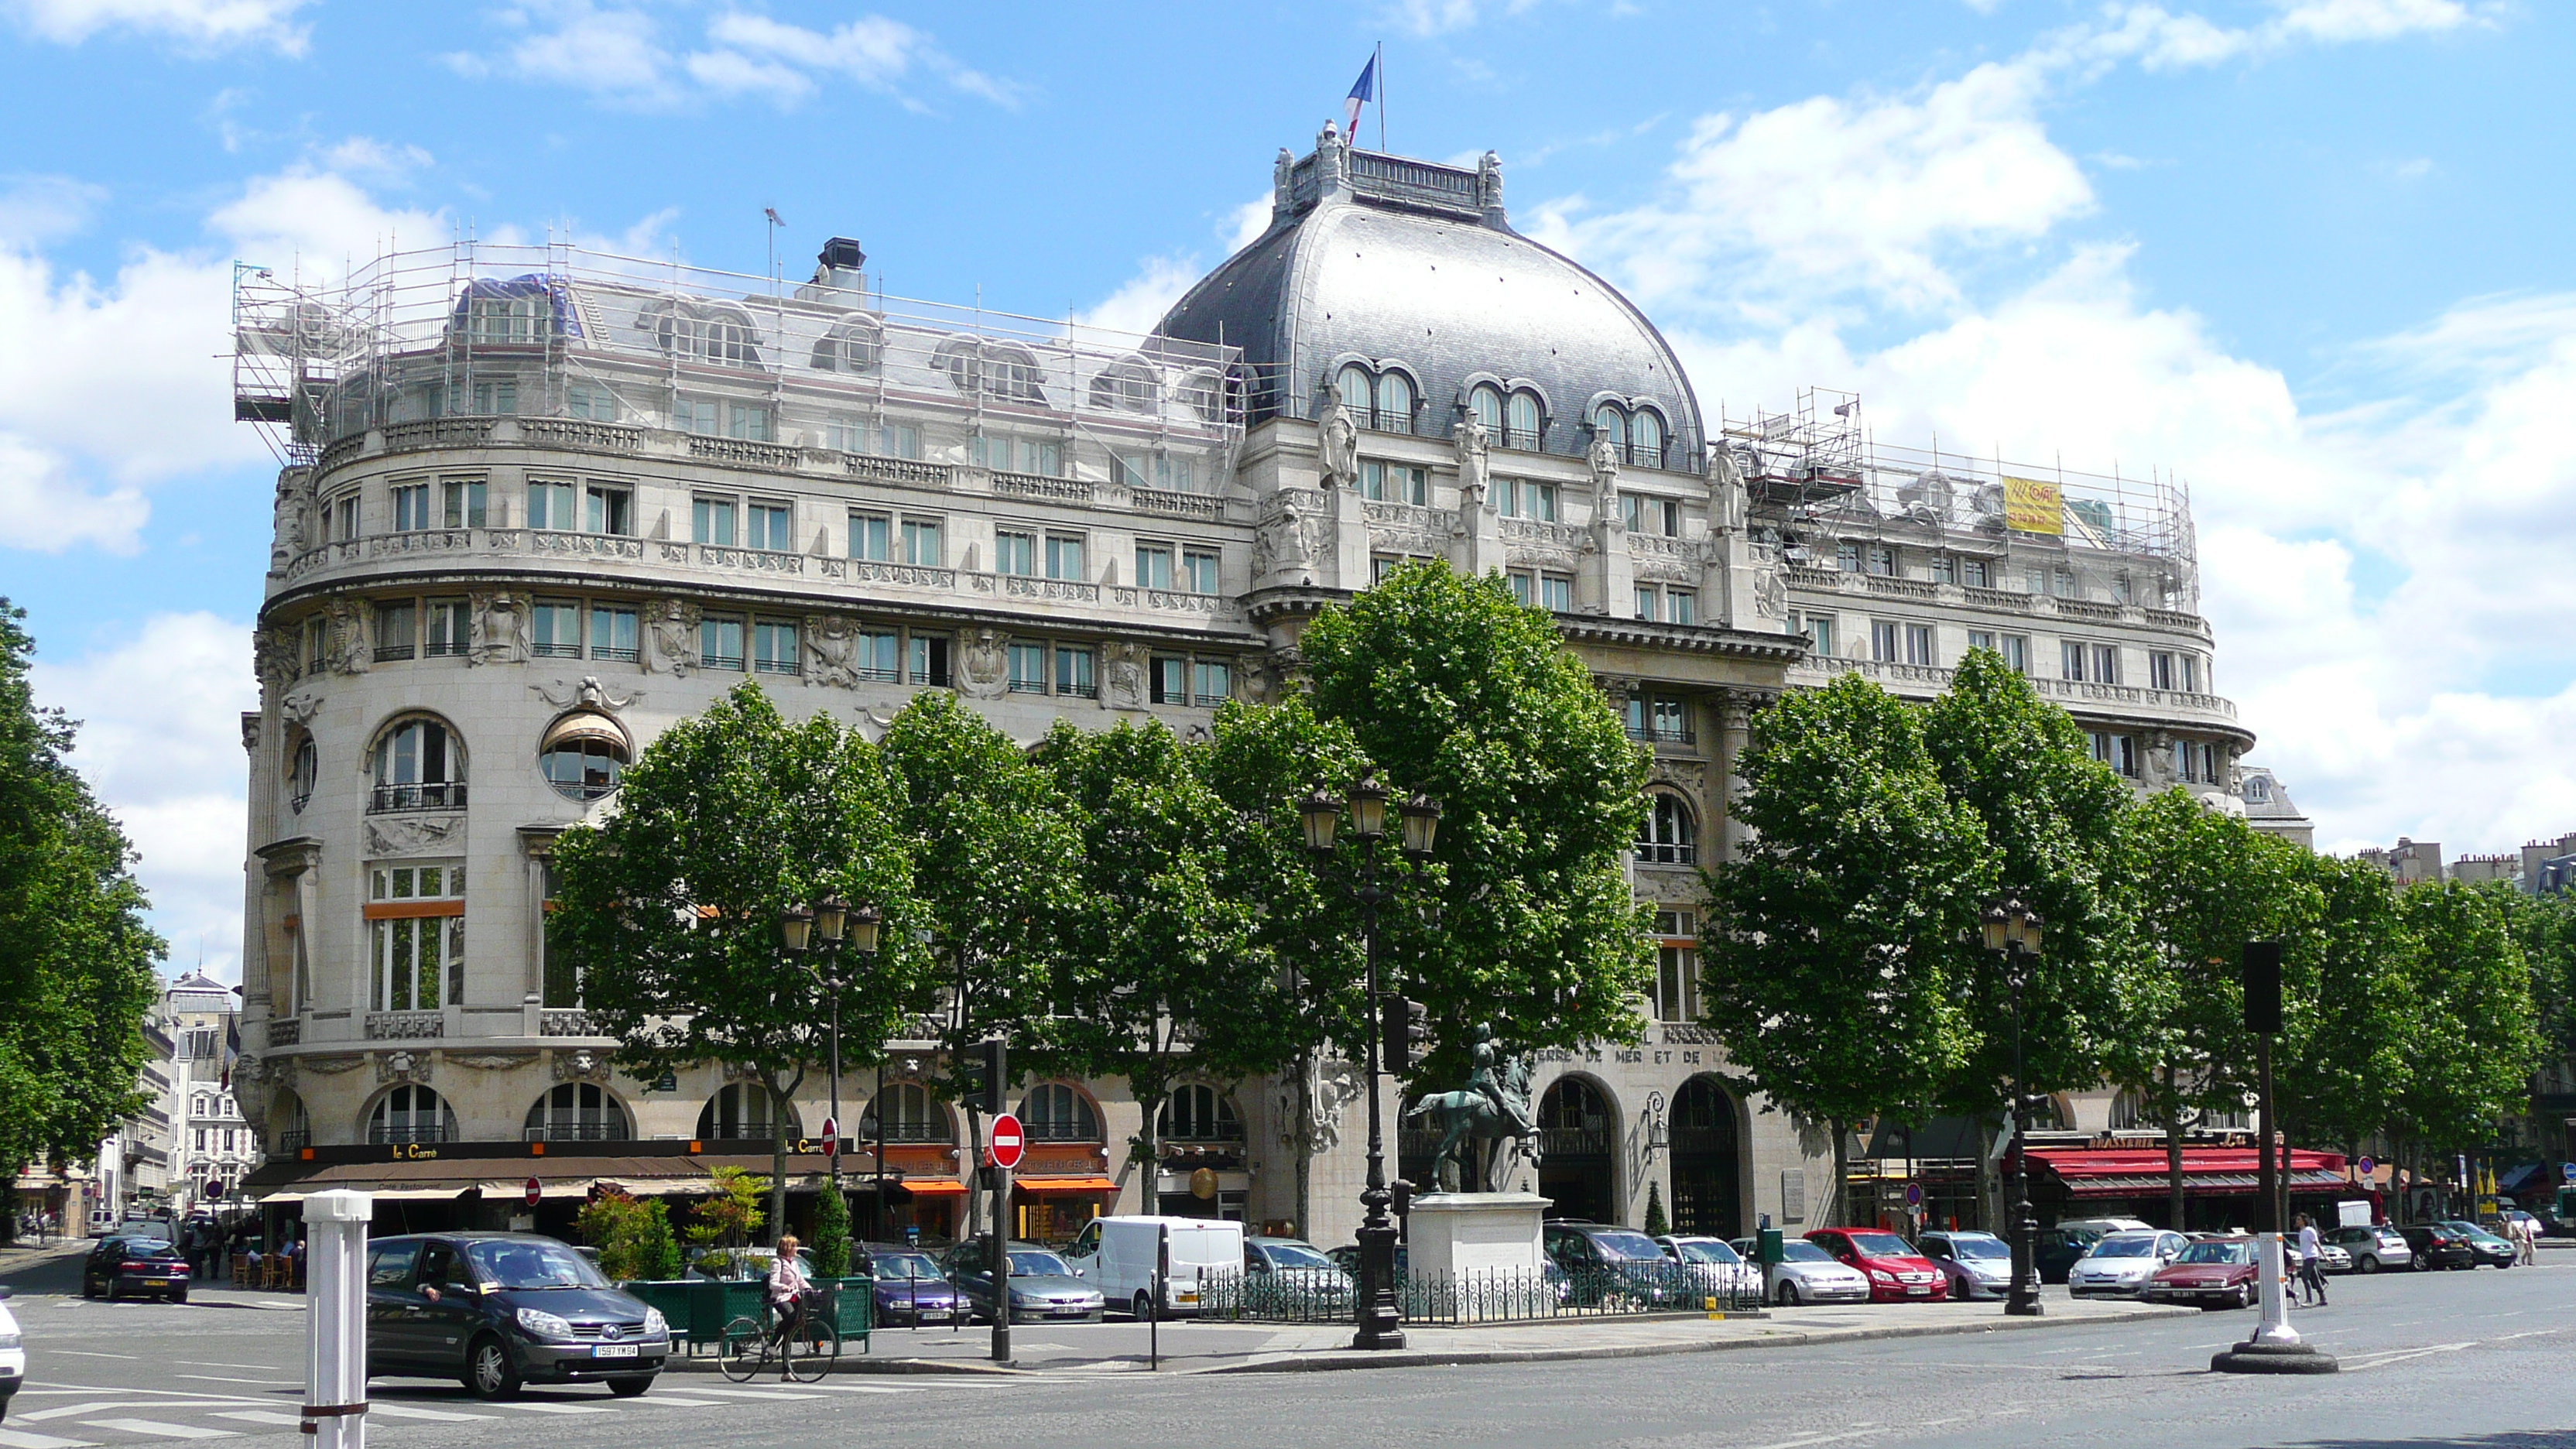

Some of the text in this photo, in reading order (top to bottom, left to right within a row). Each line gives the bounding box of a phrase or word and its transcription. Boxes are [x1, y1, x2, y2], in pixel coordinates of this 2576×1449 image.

[1535, 1050, 1572, 1062] ERRE
[1585, 1050, 1602, 1063] DE
[1615, 1050, 1642, 1064] MER
[1655, 1050, 1672, 1064] ET
[1684, 1051, 1700, 1065] DE
[2088, 1137, 2155, 1148] BRASSERIE
[598, 1346, 616, 1355] 1597
